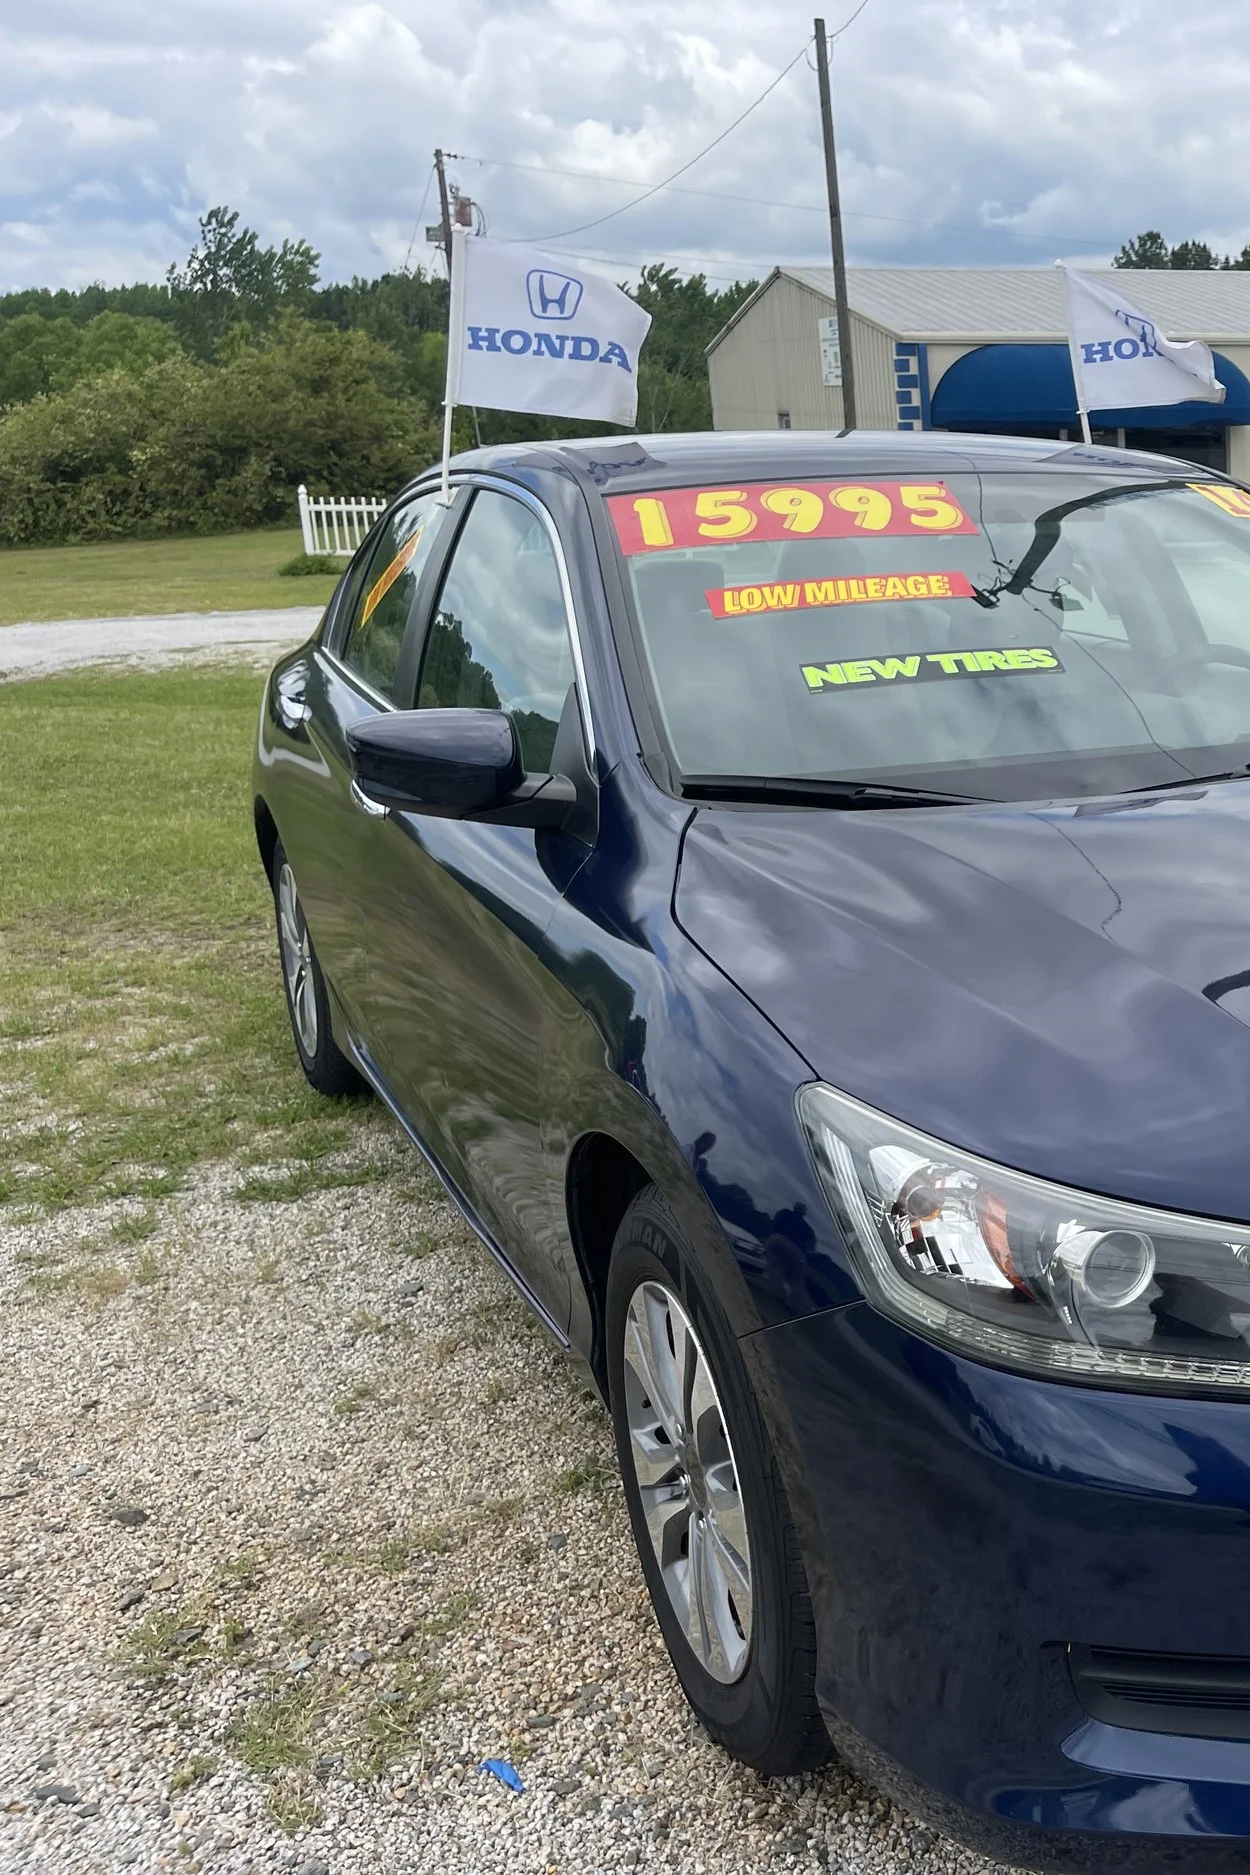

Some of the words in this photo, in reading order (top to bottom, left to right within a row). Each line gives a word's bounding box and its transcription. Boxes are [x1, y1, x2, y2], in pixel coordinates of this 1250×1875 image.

[467, 326, 632, 373] HONDA
[633, 486, 964, 547] 15995
[723, 583, 801, 615] LOW
[804, 575, 952, 606] MILEAGE
[801, 655, 921, 688] NEW
[925, 648, 1059, 674] TIRES
